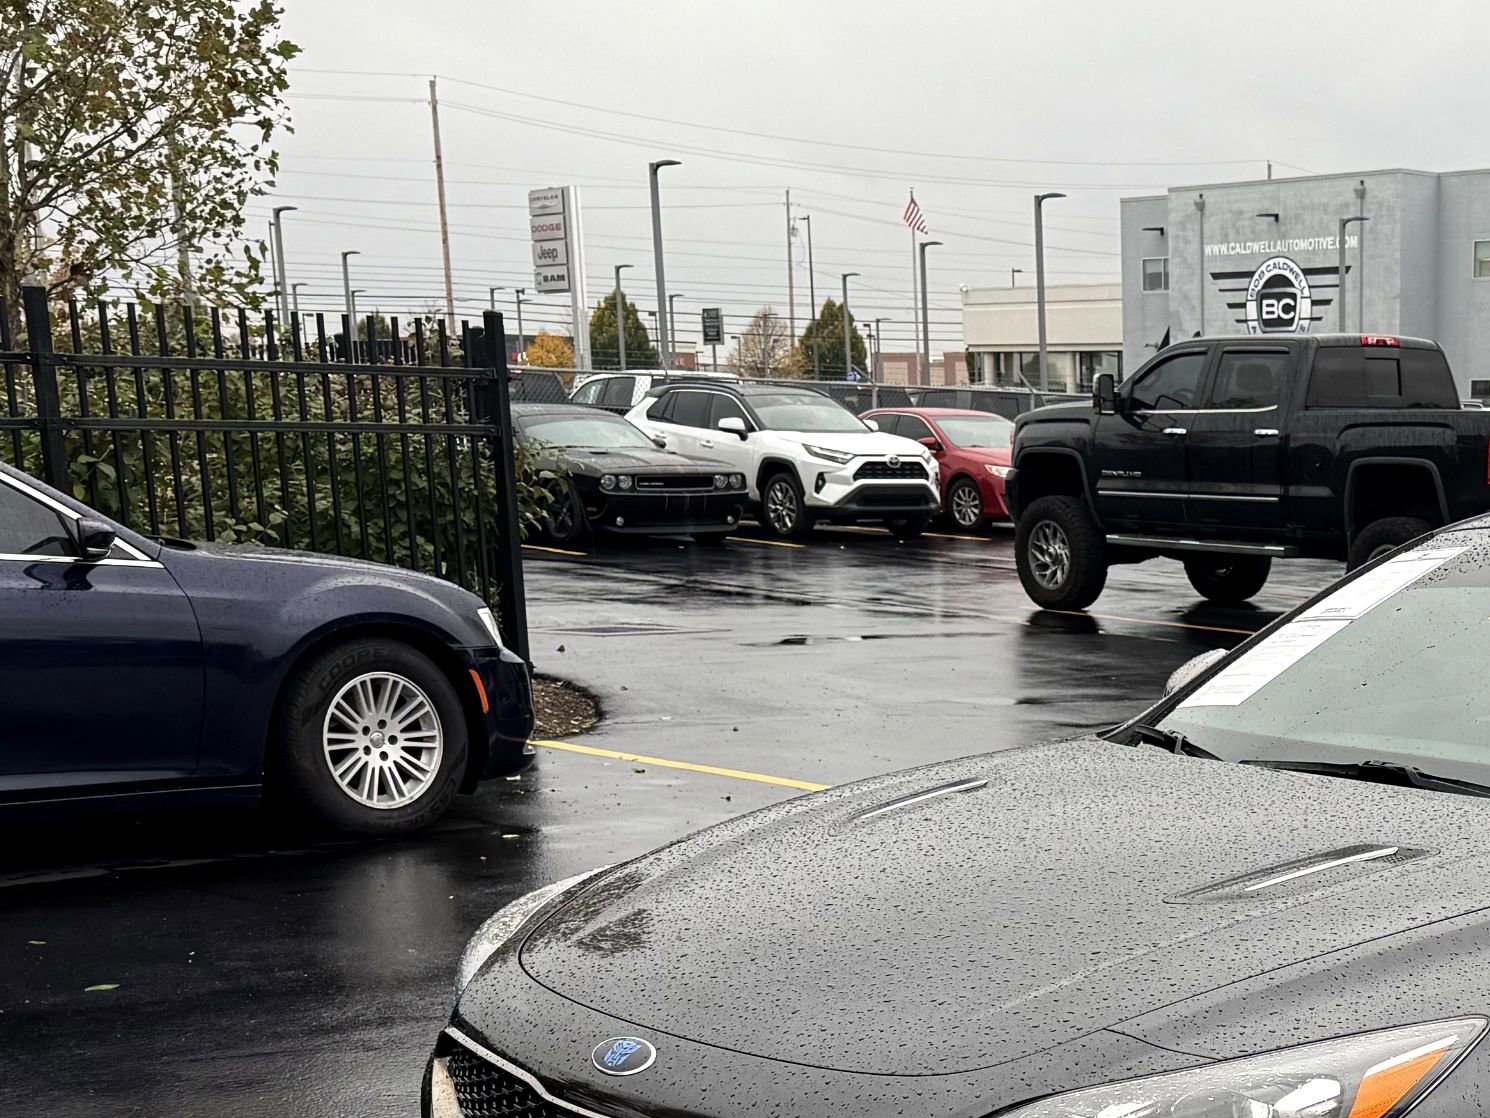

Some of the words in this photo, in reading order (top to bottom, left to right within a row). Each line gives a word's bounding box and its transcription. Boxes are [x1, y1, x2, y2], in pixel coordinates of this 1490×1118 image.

[531, 223, 562, 233] DODGE
[537, 245, 559, 262] Jeep
[543, 274, 566, 283] RAM
[1249, 270, 1266, 299] BOB
[1265, 261, 1306, 296] CALDWELL
[1262, 298, 1296, 320] BC
